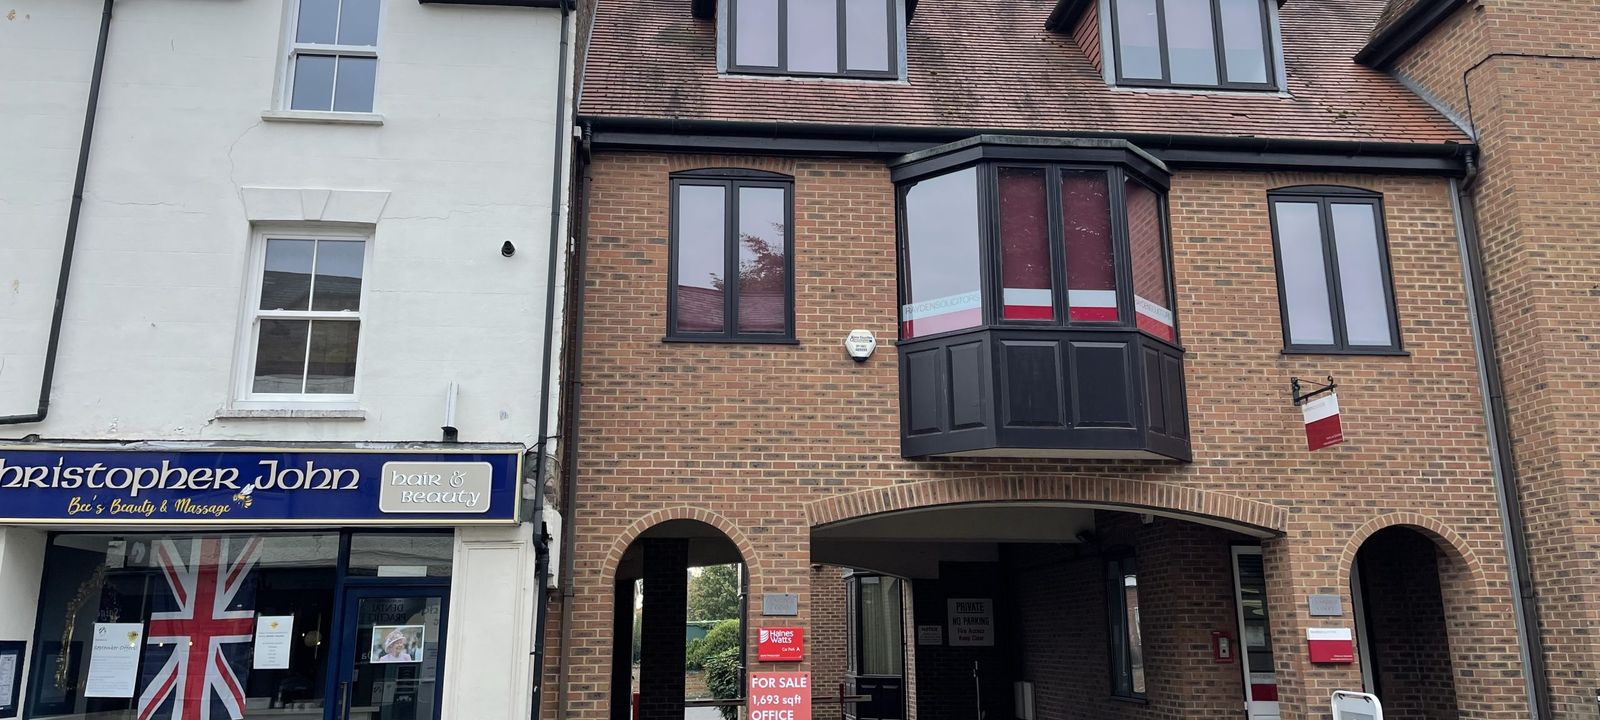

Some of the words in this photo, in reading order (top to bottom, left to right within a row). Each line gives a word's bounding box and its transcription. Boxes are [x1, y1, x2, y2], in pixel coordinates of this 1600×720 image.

[254, 459, 360, 490] John
[391, 470, 442, 486] hair
[449, 470, 467, 488] &
[67, 494, 105, 515] Bee's
[110, 498, 157, 517] Beauty
[160, 499, 168, 513] &
[174, 498, 231, 517] Massage
[401, 489, 481, 507] Beauty
[956, 602, 984, 612] PRIVATE
[752, 677, 776, 688] FOR
[778, 677, 807, 688] SALE
[751, 695, 780, 707] 1,693
[782, 695, 802, 707] sqft
[751, 710, 794, 720] OFFICE
